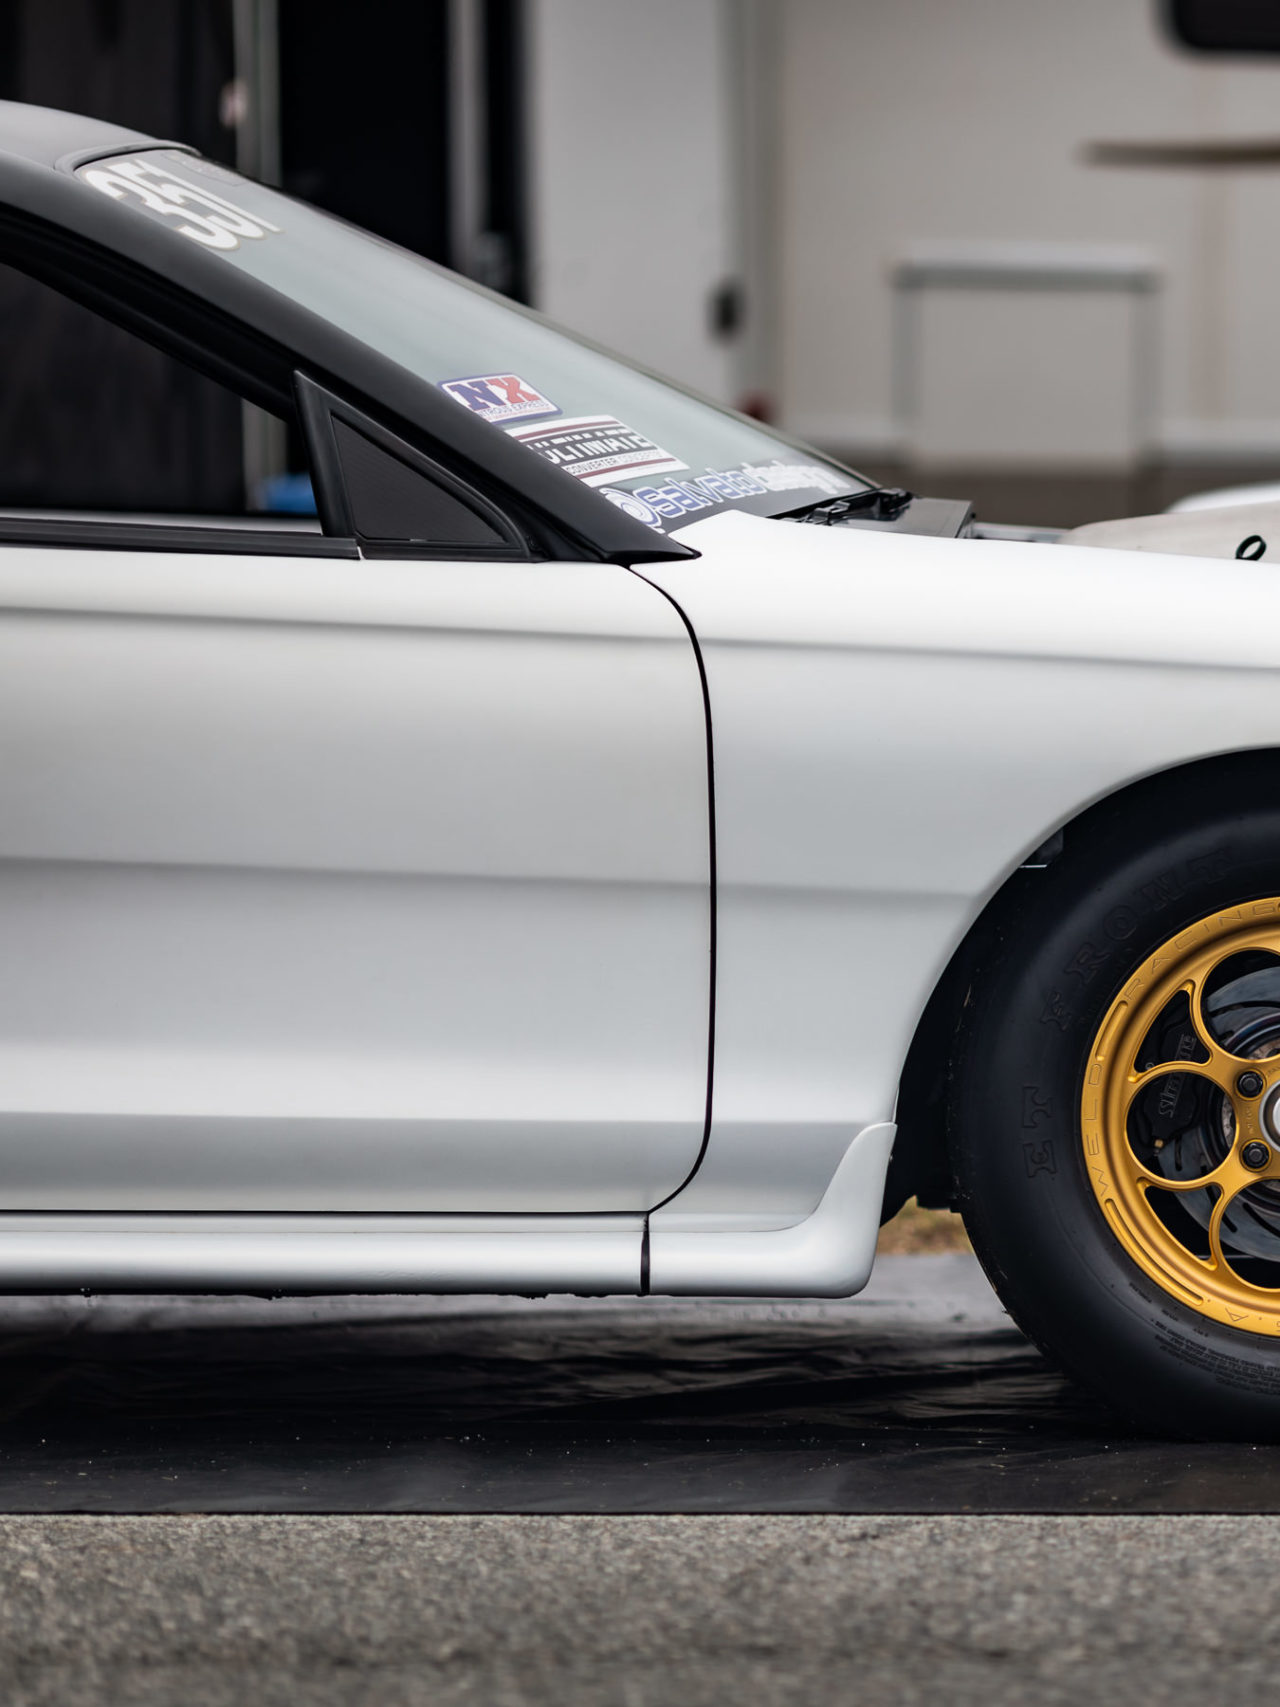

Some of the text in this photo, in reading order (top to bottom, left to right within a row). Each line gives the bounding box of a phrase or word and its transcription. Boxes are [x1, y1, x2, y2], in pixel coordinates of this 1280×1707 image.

[84, 158, 283, 250] 351
[447, 376, 540, 411] NX
[565, 457, 617, 475] CONVERTER
[1084, 1062, 1110, 1198] WELD
[1123, 900, 1278, 1001] RACING
[1022, 1085, 1057, 1178] ET
